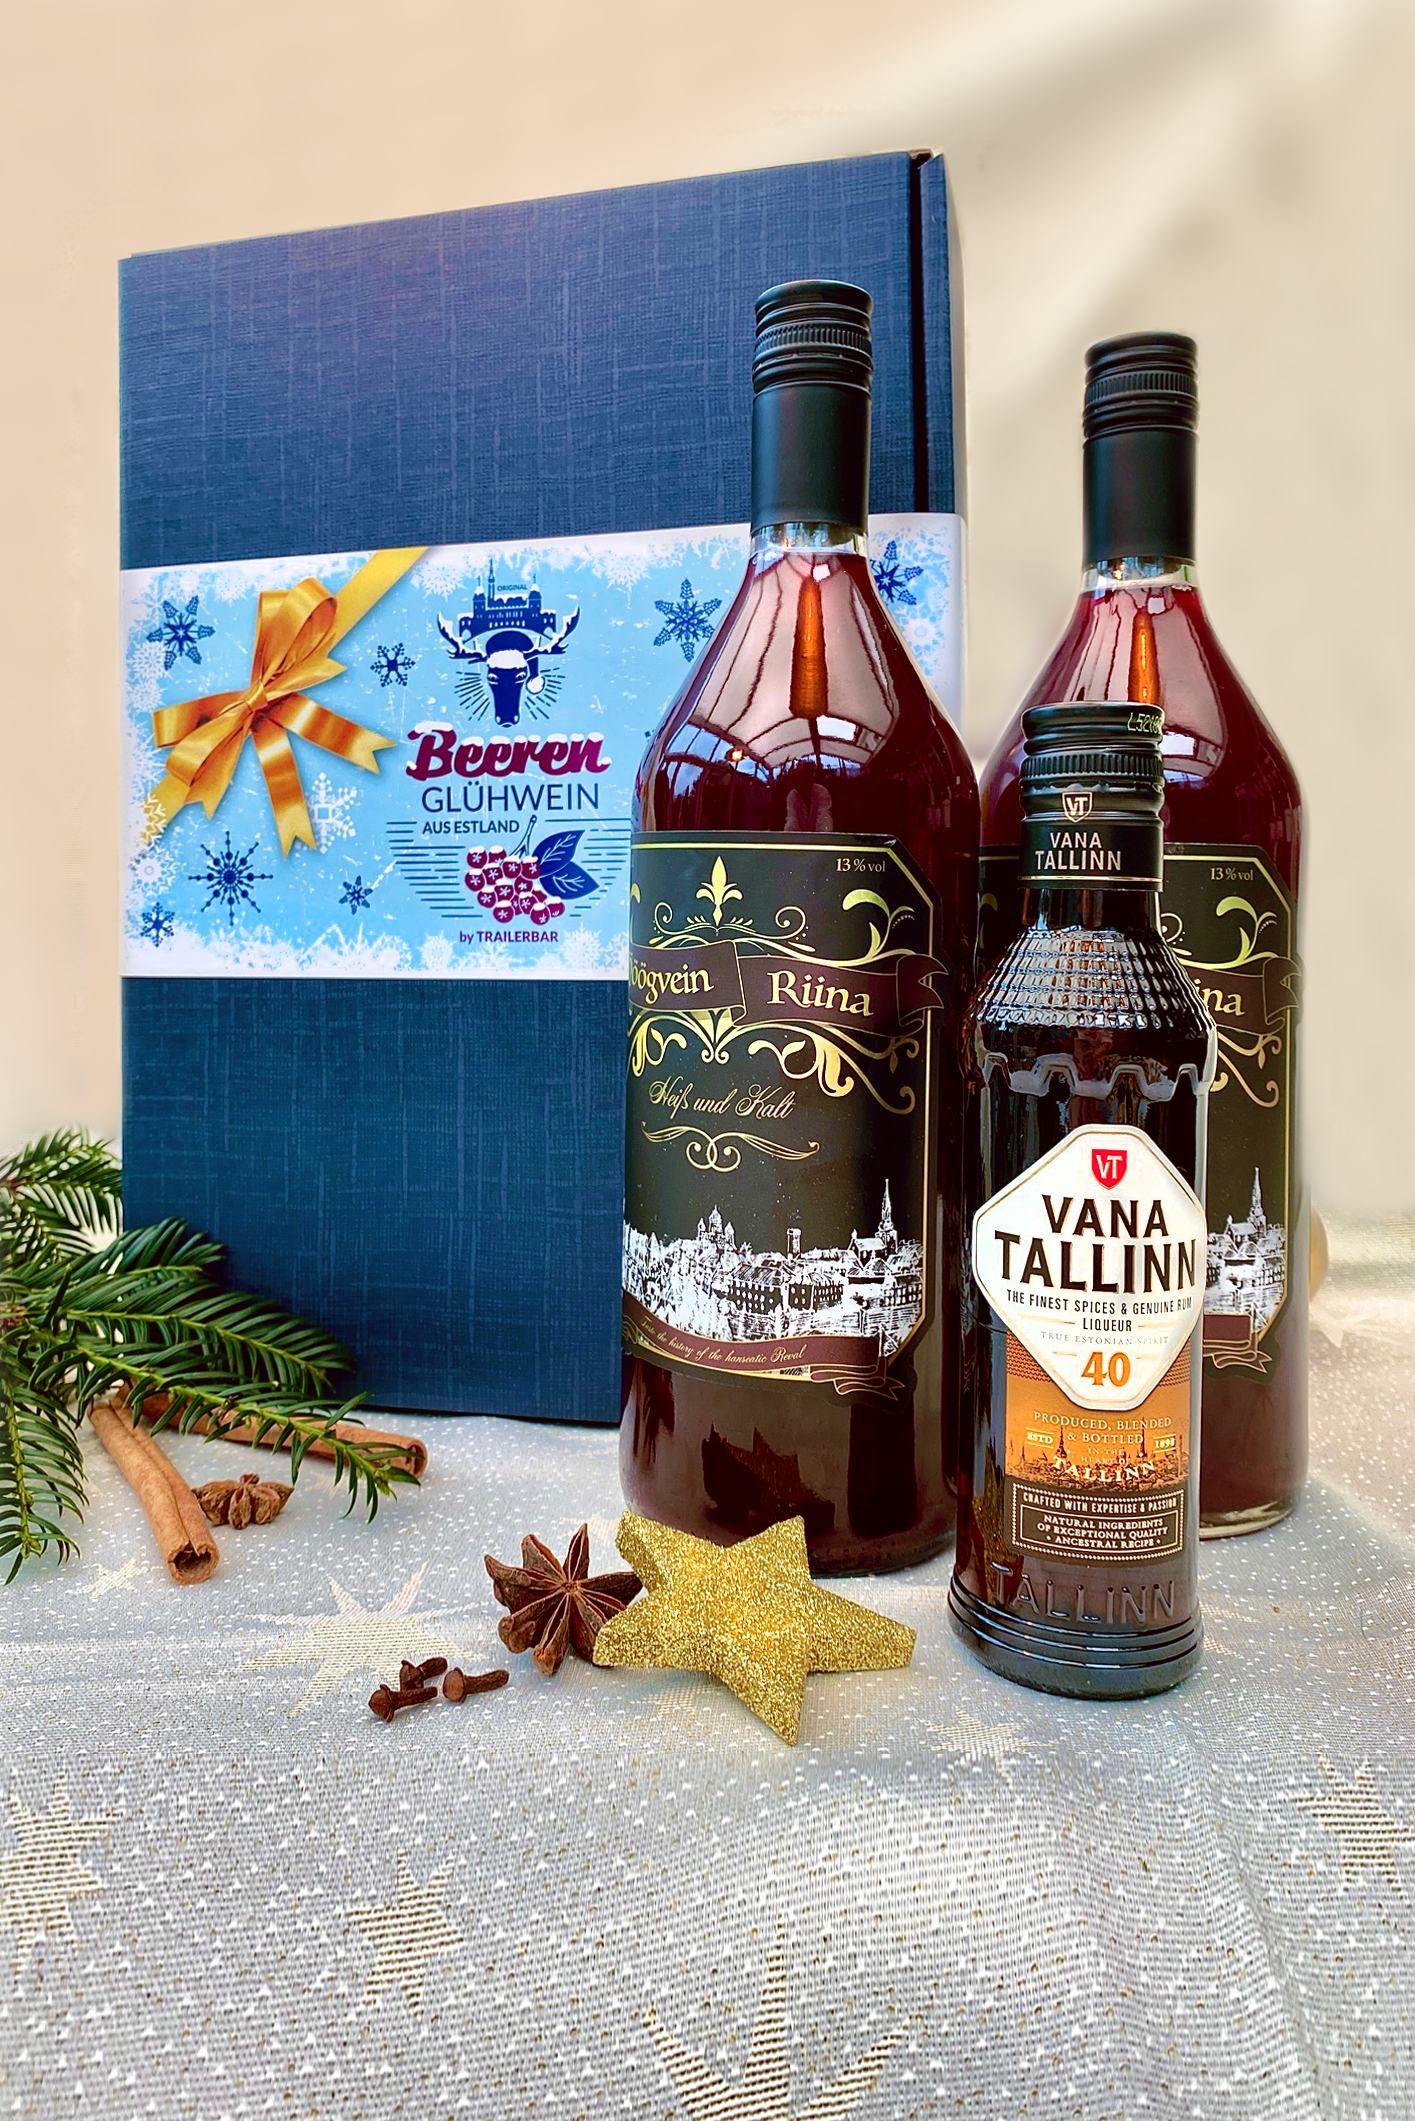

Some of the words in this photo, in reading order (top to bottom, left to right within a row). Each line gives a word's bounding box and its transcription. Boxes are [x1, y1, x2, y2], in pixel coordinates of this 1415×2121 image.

[406, 722, 612, 781] Beeren
[422, 781, 599, 812] GLÜHWEIN
[1066, 796, 1088, 816] VT
[422, 821, 451, 834] AUS
[454, 819, 520, 834] ESTLAND
[1049, 832, 1102, 849] VANA
[1035, 850, 1121, 871] TALLINN
[459, 931, 474, 945] by
[477, 931, 558, 943] TRAILERBAR
[767, 972, 874, 1017] Riina
[694, 1089, 737, 1114] und
[735, 1084, 796, 1120] Kalt
[1095, 1154, 1123, 1180] VT
[1042, 1194, 1169, 1238] VANA
[994, 1230, 1197, 1294] TALLINN
[1006, 1289, 1025, 1304] THE
[1029, 1294, 1069, 1311] FINEST
[1074, 1300, 1115, 1315] SPICES
[1121, 1303, 1127, 1315] &
[1133, 1300, 1174, 1315] GENUINE
[1177, 1297, 1192, 1311] RUM
[1083, 1318, 1132, 1332] LIQUEUR
[1041, 1331, 1069, 1342] TRUE
[1075, 1335, 1133, 1345] ESTONIAN
[668, 1338, 694, 1358] history
[695, 1347, 710, 1361] of
[708, 1348, 722, 1361] the
[724, 1350, 767, 1363] hanseatic
[770, 1344, 807, 1363] Reval
[1081, 1352, 1131, 1387] 40
[1034, 1412, 1111, 1431] PRODUCED,
[1117, 1417, 1172, 1431] BLENDED
[1026, 1432, 1053, 1444] ESTD
[1067, 1433, 1076, 1442] &
[1082, 1433, 1143, 1444] BOTTLED
[1053, 1455, 1155, 1482] TALLINN
[1023, 1492, 1060, 1509] CRAFTED
[1065, 1501, 1088, 1512] WITH
[1092, 1503, 1137, 1514] EXPERTISE
[1140, 1503, 1145, 1513] &
[1149, 1498, 1177, 1512] PASSION
[1037, 1522, 1050, 1532] OF
[1053, 1525, 1126, 1539] EXCEPTIONAL
[1129, 1527, 1168, 1539] QUALITY
[1044, 1515, 1095, 1529] NATURAL
[1099, 1518, 1163, 1530] INGREDIENTS
[1055, 1535, 1118, 1549] ANCESTRAL
[1121, 1538, 1154, 1549] RECIPE
[991, 1561, 1175, 1624] TALLINN
